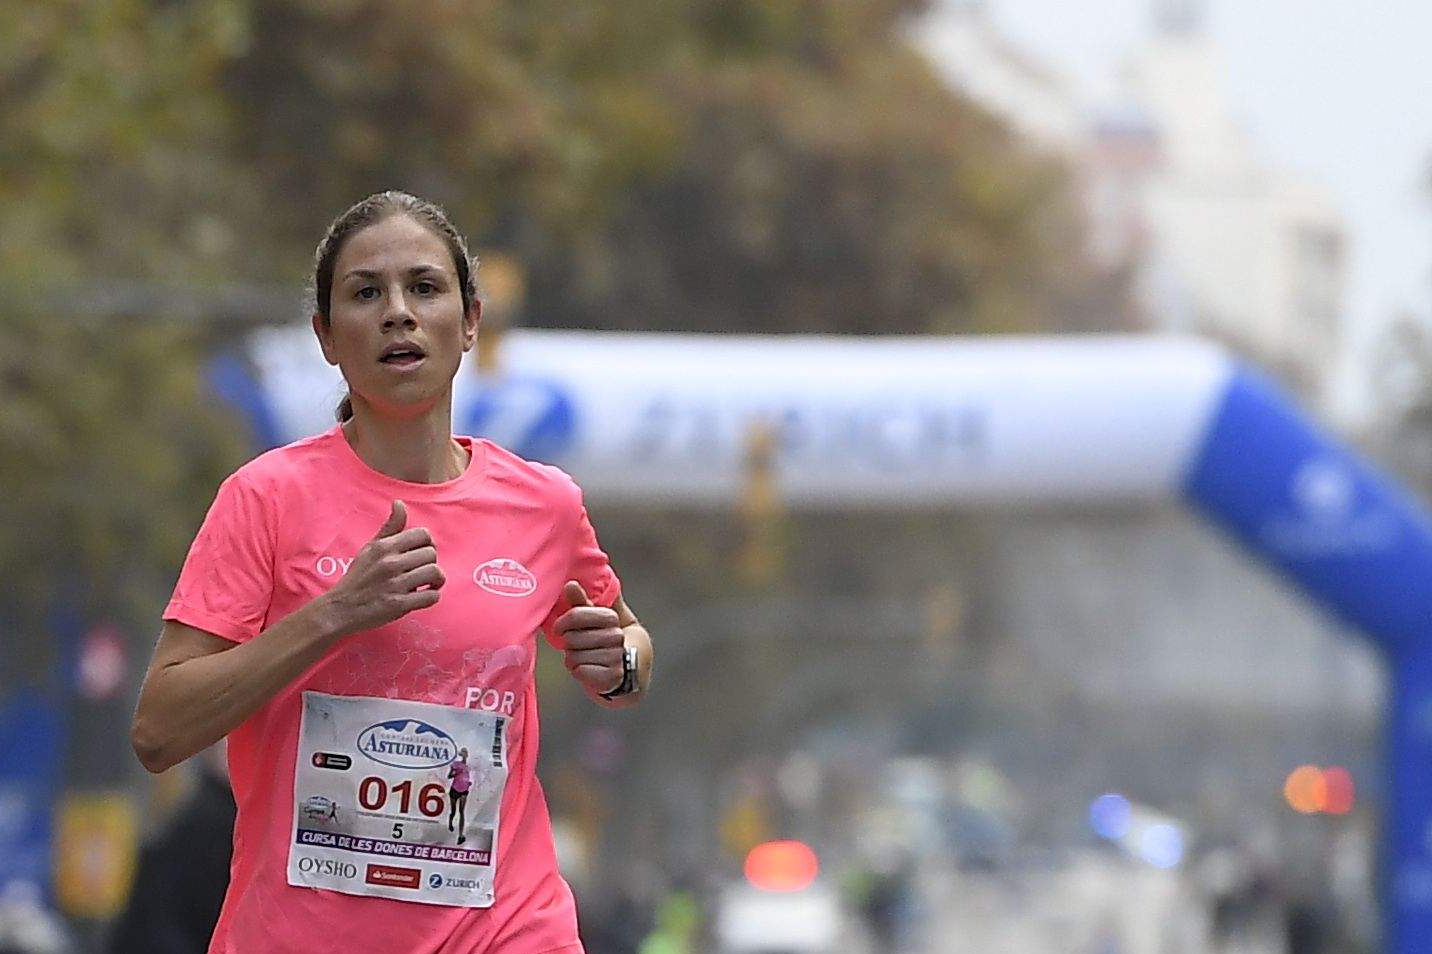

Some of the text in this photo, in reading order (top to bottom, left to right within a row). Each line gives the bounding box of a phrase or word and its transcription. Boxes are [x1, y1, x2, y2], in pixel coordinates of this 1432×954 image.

[316, 556, 355, 577] OY
[464, 686, 515, 714] POR
[364, 733, 450, 761] ASTURIANA
[358, 776, 446, 818] 016
[391, 823, 404, 839] 5
[301, 831, 489, 863] CURSA DE LES DONES DE BARCELONA
[298, 857, 358, 879] OYSHO
[445, 879, 480, 889] ZURICH
